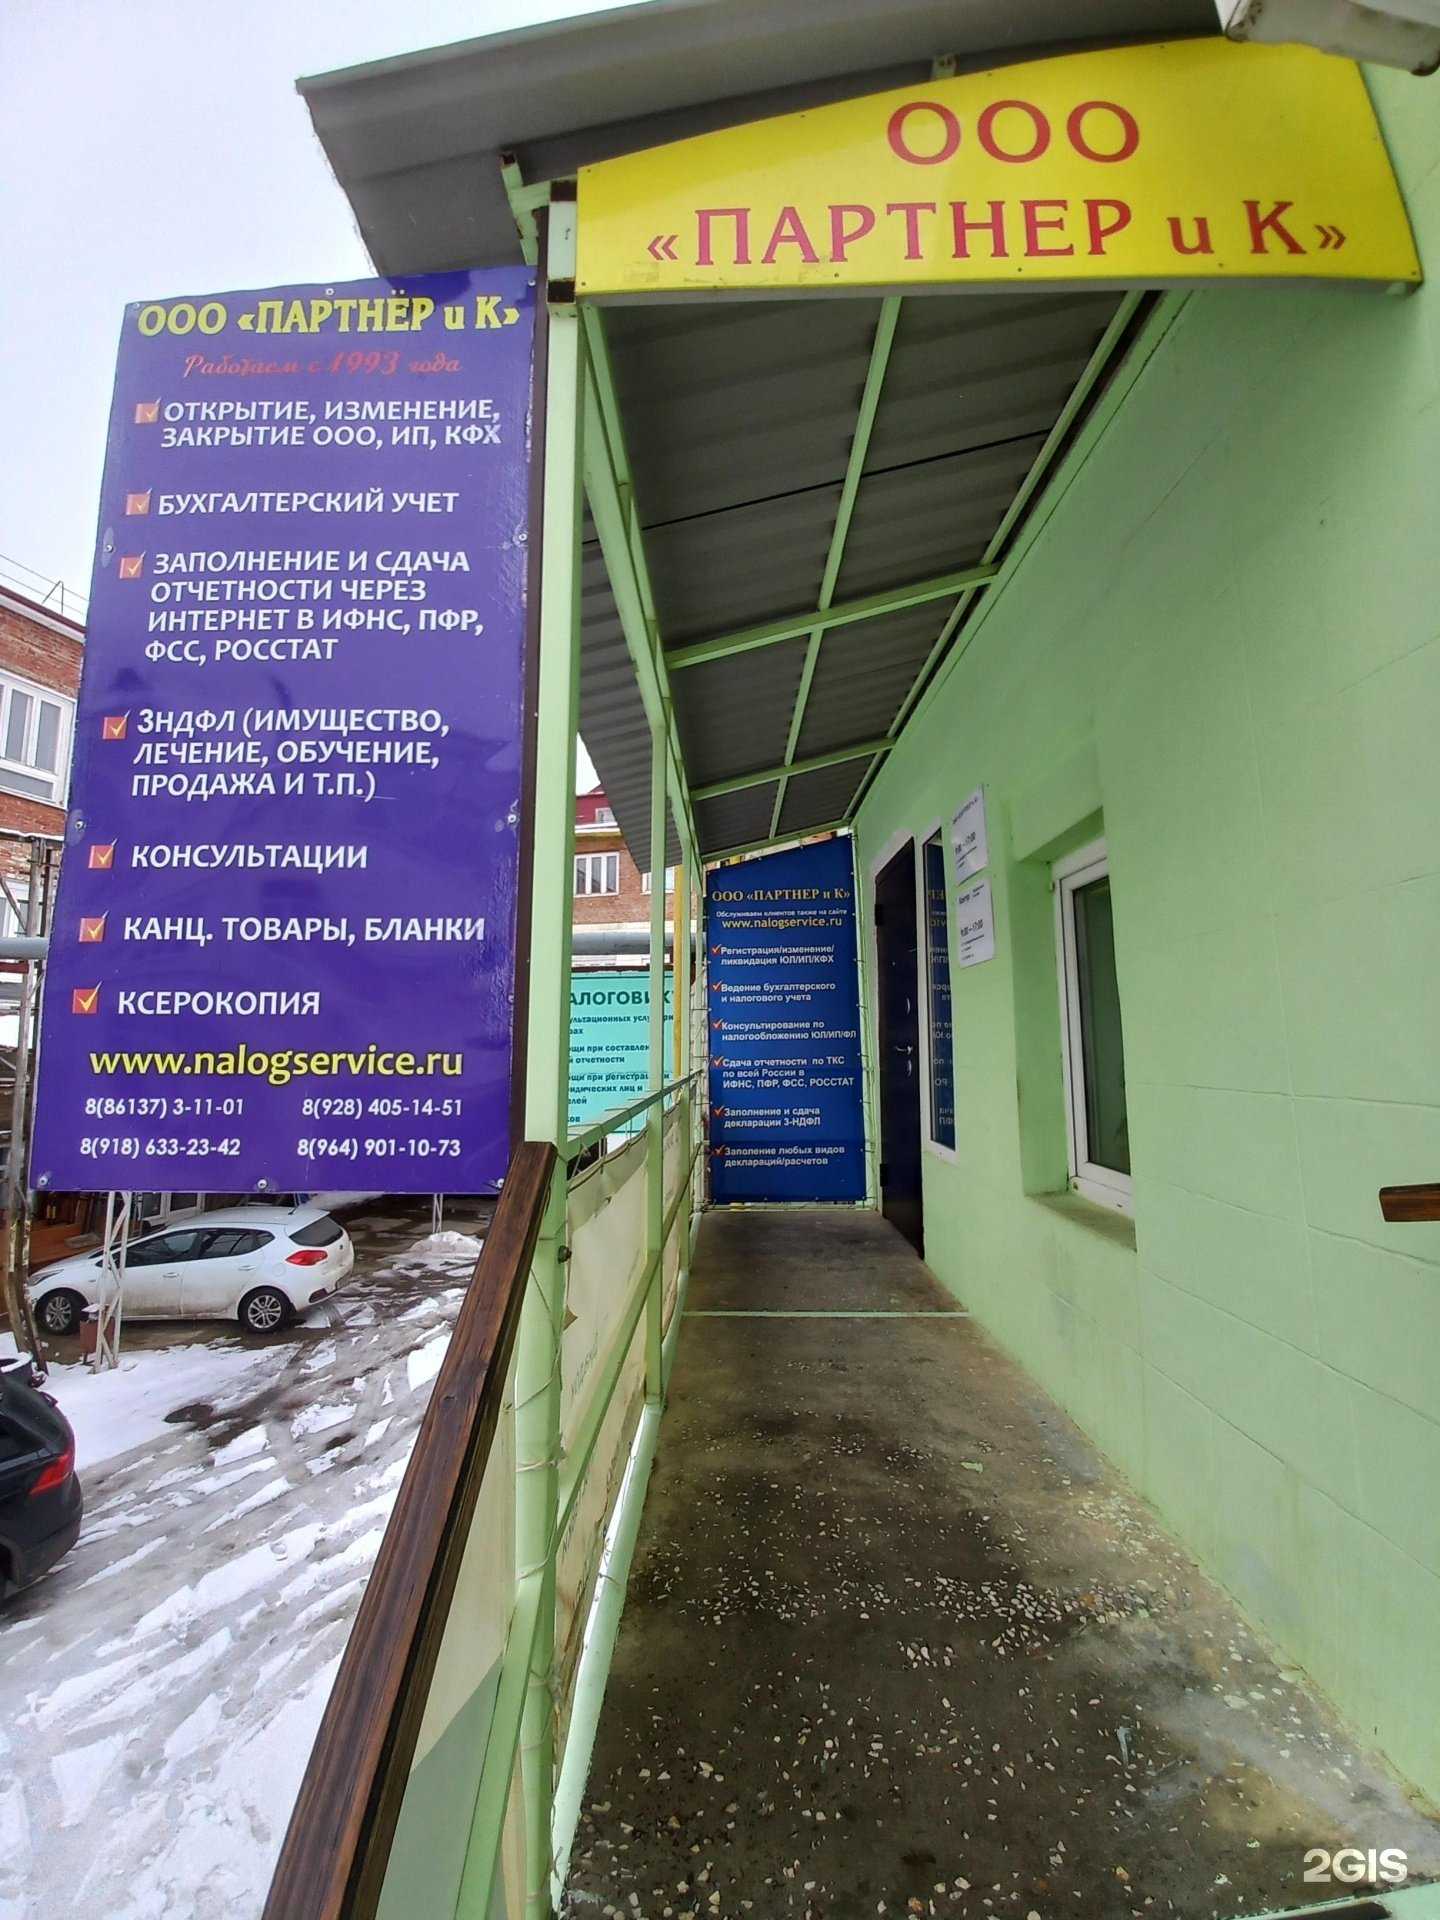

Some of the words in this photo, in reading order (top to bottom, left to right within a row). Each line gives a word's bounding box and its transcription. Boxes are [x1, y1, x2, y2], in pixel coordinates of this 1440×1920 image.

[887, 100, 1140, 165] ООО
[647, 199, 1132, 266] «ПАРТНЕР
[1249, 200, 1347, 257] К»
[138, 304, 227, 336] ООО
[237, 289, 436, 334] «ПАРТНЁР
[475, 296, 520, 330] К»
[182, 354, 299, 378] Работаем
[308, 363, 320, 374] с
[330, 351, 402, 376] 1993
[409, 352, 463, 373] года
[164, 400, 316, 424] ОТКРЫТИЕ,
[324, 399, 501, 422] ИЗМЕНЕНИЕ,
[161, 427, 305, 447] ЗАКРЫТИЕ
[313, 426, 383, 449] ООО,
[391, 424, 437, 449] ИП,
[445, 423, 503, 446] КФХ
[158, 488, 384, 516] БУХГАЛТЕРСКИЙ
[392, 492, 459, 513] УЧЕТ
[153, 551, 339, 574] ЗАПОЛНЕНИЕ
[347, 552, 367, 572] И
[376, 551, 470, 576] СДАЧА
[150, 580, 331, 602] ОТЧЕТНОСТИ
[340, 580, 427, 601] ЧЕРЕЗ
[148, 609, 289, 631] ИНТЕРНЕТ
[298, 609, 314, 630] В
[323, 608, 412, 635] ИФНС,
[419, 608, 484, 636] ПФР,
[144, 639, 207, 667] ФСС,
[214, 638, 338, 660] РОССТАТ
[241, 706, 450, 738] (ИМУЩЕСТВО,
[133, 742, 269, 768] ЛЕЧЕНИЕ,
[277, 741, 440, 767] ОБУЧЕНИЕ,
[131, 773, 276, 801] ПРОДАЖА
[285, 774, 304, 795] И
[312, 772, 377, 803] Т.П.)
[131, 846, 368, 874] КОНСУЛЬТАЦИИ
[712, 891, 743, 901] ООО
[747, 888, 819, 900] «ПАРТНЕР
[834, 889, 850, 899] К»
[123, 919, 214, 947] КАНЦ.
[222, 918, 356, 946] ТОВАРЫ,
[364, 917, 485, 942] БЛАНКИ
[722, 917, 842, 929] www.nalogservice.ru
[721, 945, 834, 955] Регистрация/изменение/
[721, 957, 777, 966] ликвидация
[780, 955, 834, 964] ЮЛ/ИП/КФХ
[721, 984, 761, 992] Ведение
[764, 983, 835, 992] бухгалтерского
[118, 991, 320, 1016] КСЕРОКОПИЯ
[785, 994, 811, 1003] учета
[722, 1022, 810, 1032] Консультирование
[722, 1032, 808, 1041] налогообложению
[811, 1030, 856, 1038] ЮЛ/ИП/ФЛ
[89, 1044, 463, 1084] www.nalogservice.ru
[722, 1059, 752, 1068] Сдача
[826, 1057, 845, 1065] ТКС
[762, 1069, 796, 1077] России
[723, 1080, 755, 1089] ИФНС,
[757, 1080, 780, 1088] ПФР,
[782, 1079, 807, 1088] ФСС,
[810, 1078, 854, 1086] РОССТАТ
[85, 1098, 168, 1118] 8(86137)
[173, 1098, 244, 1116] 3-11-01
[302, 1098, 363, 1118] 8(928)
[368, 1098, 462, 1116] 405-14-51
[724, 1108, 782, 1116] Заполнение
[792, 1108, 820, 1116] сдача
[724, 1120, 781, 1128] декларации
[784, 1118, 821, 1126] 3-НДФЛ
[80, 1137, 140, 1158] 8(918)
[145, 1139, 241, 1156] 633-23-42
[297, 1139, 359, 1159] 8(964)
[364, 1139, 461, 1157] 901-10-73
[725, 1157, 828, 1167] деклараций/расчетов
